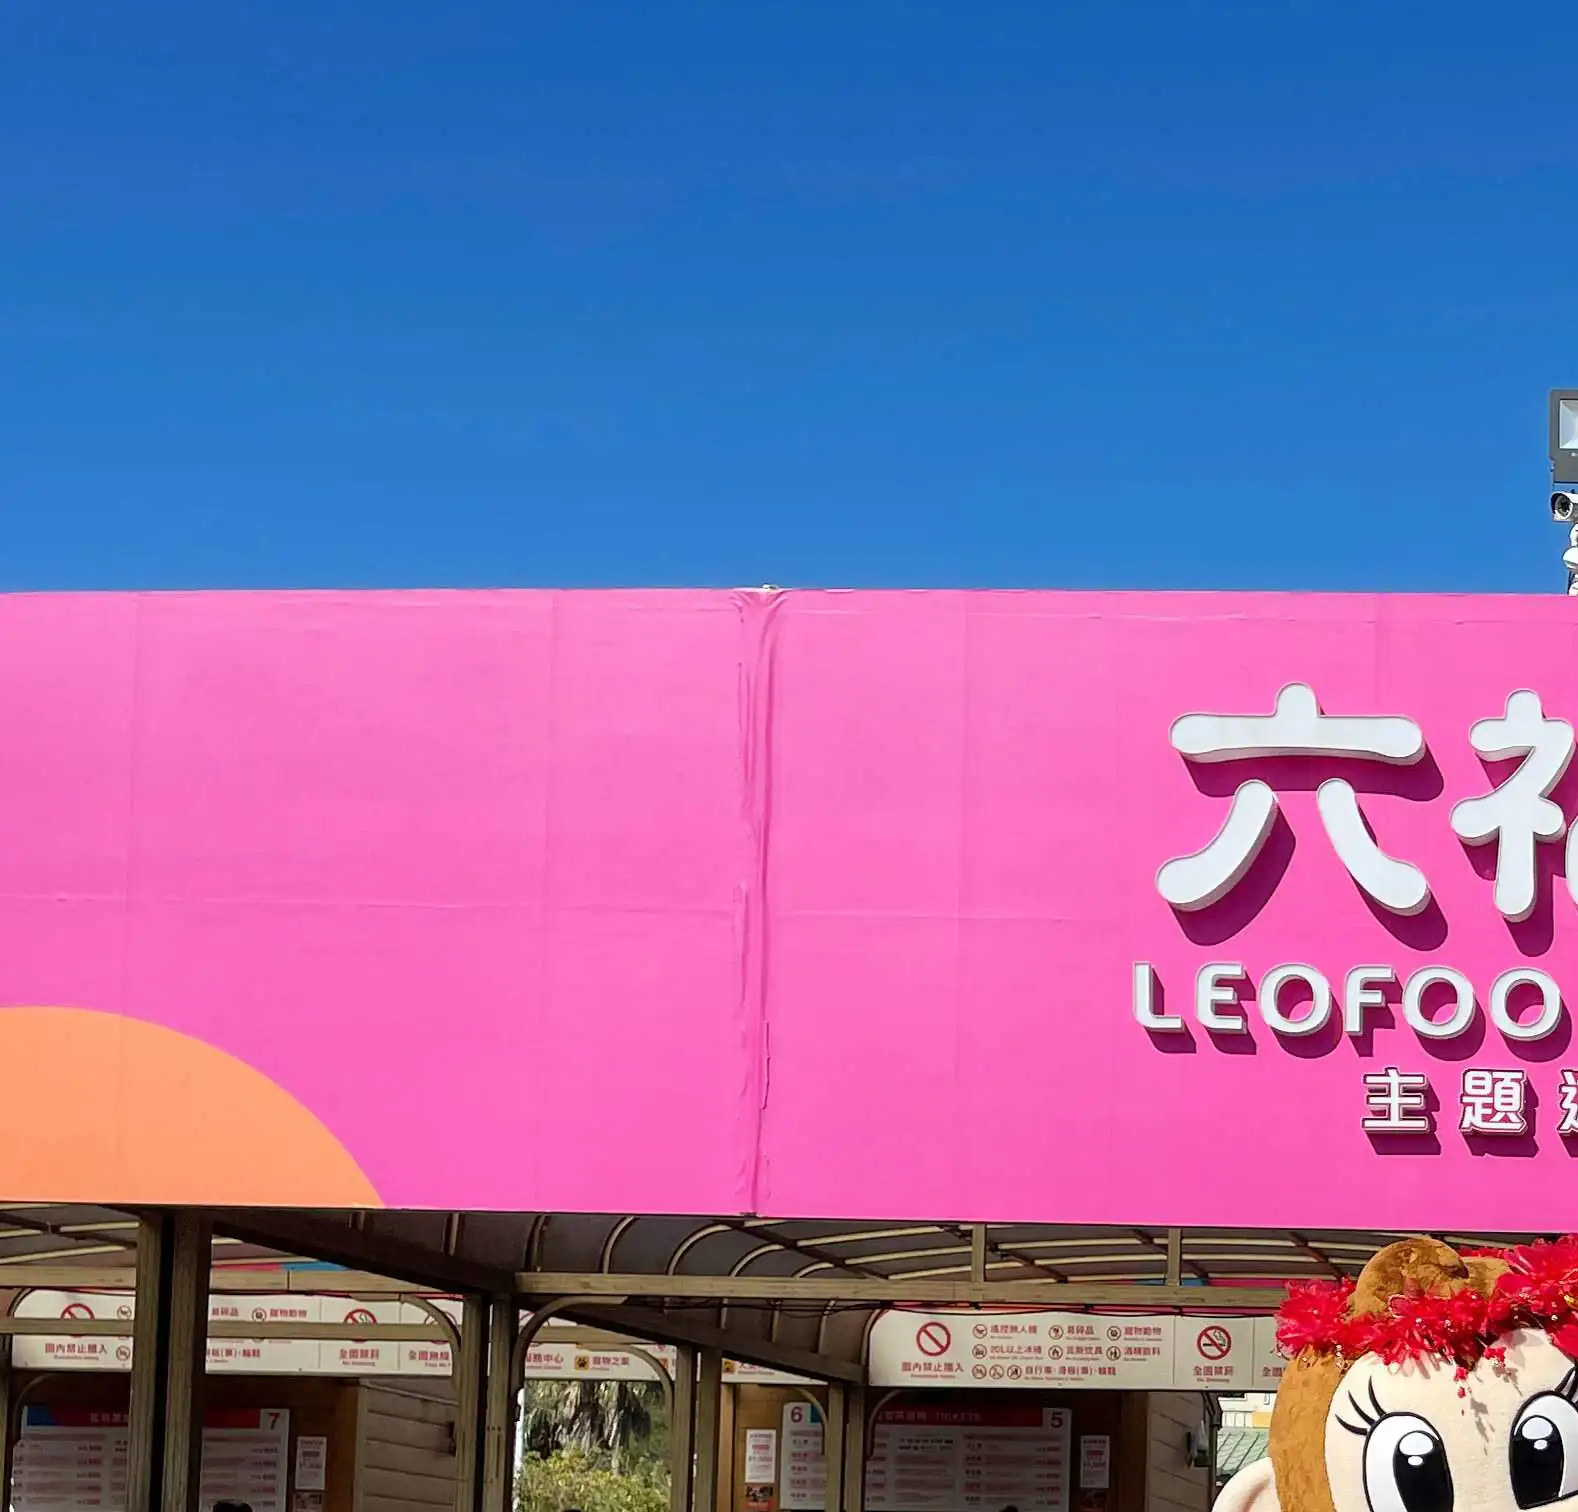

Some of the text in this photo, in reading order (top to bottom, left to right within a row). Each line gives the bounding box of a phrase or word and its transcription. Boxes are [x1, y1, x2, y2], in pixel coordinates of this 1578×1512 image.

[1132, 962, 1563, 1042] LEOFOO
[267, 1412, 280, 1430] 7
[790, 1406, 803, 1423] 6
[1051, 1412, 1064, 1428] 5
